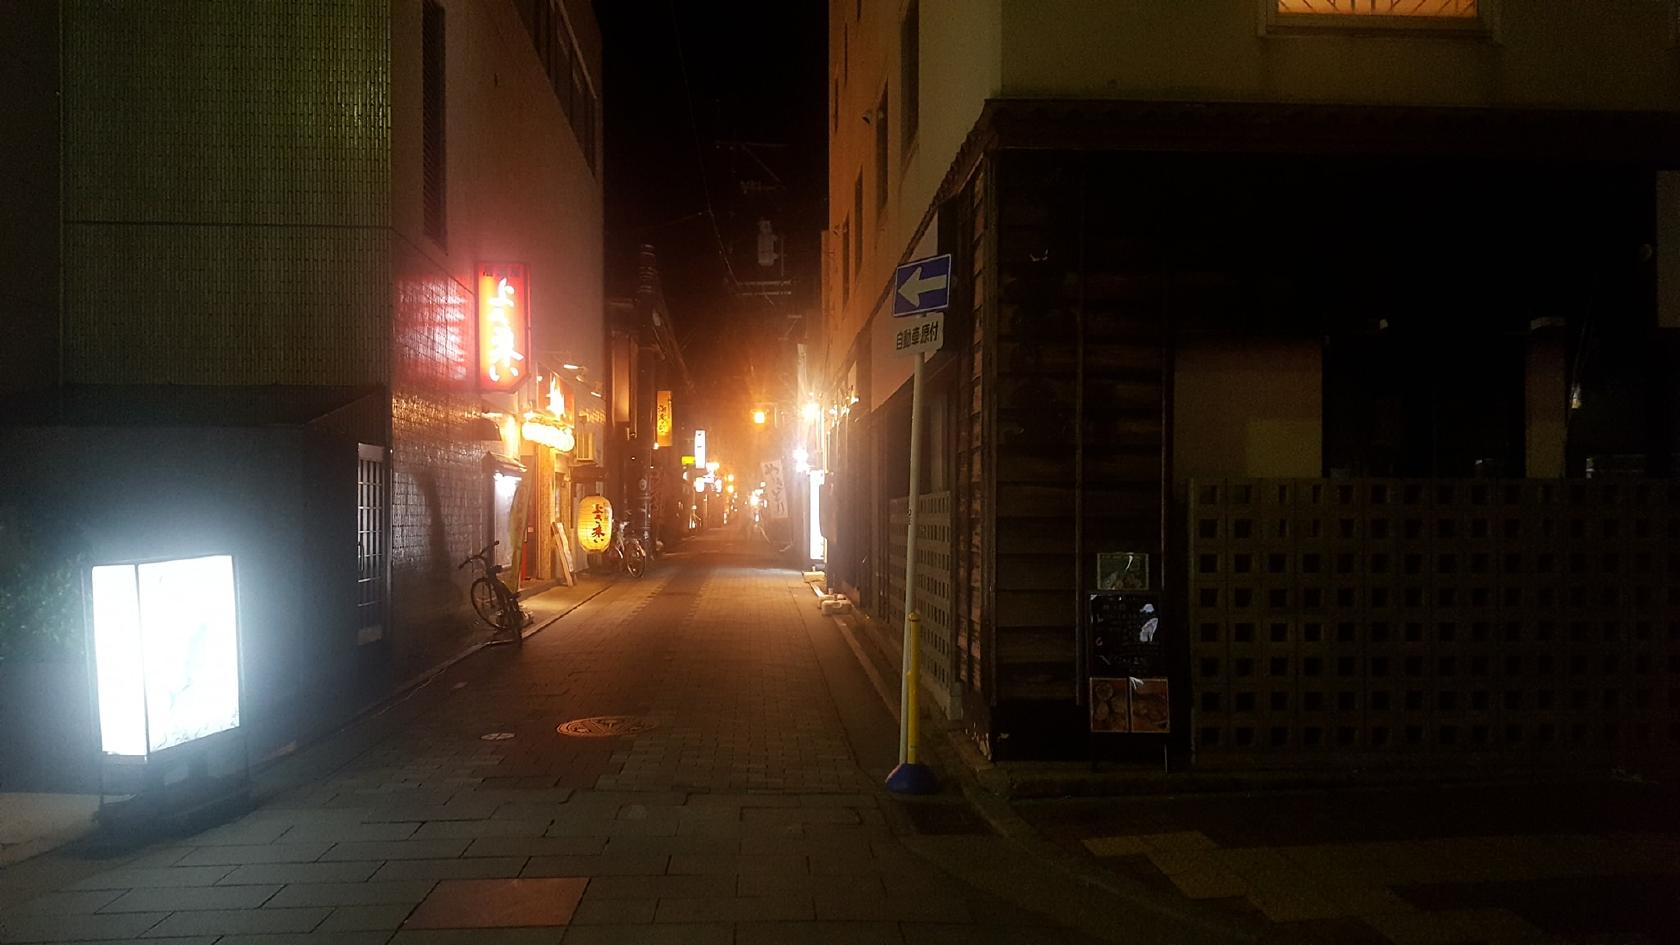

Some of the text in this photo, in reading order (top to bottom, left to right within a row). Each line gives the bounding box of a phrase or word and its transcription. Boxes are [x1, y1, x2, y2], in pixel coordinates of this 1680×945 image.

[896, 321, 939, 350] 自動車原付
